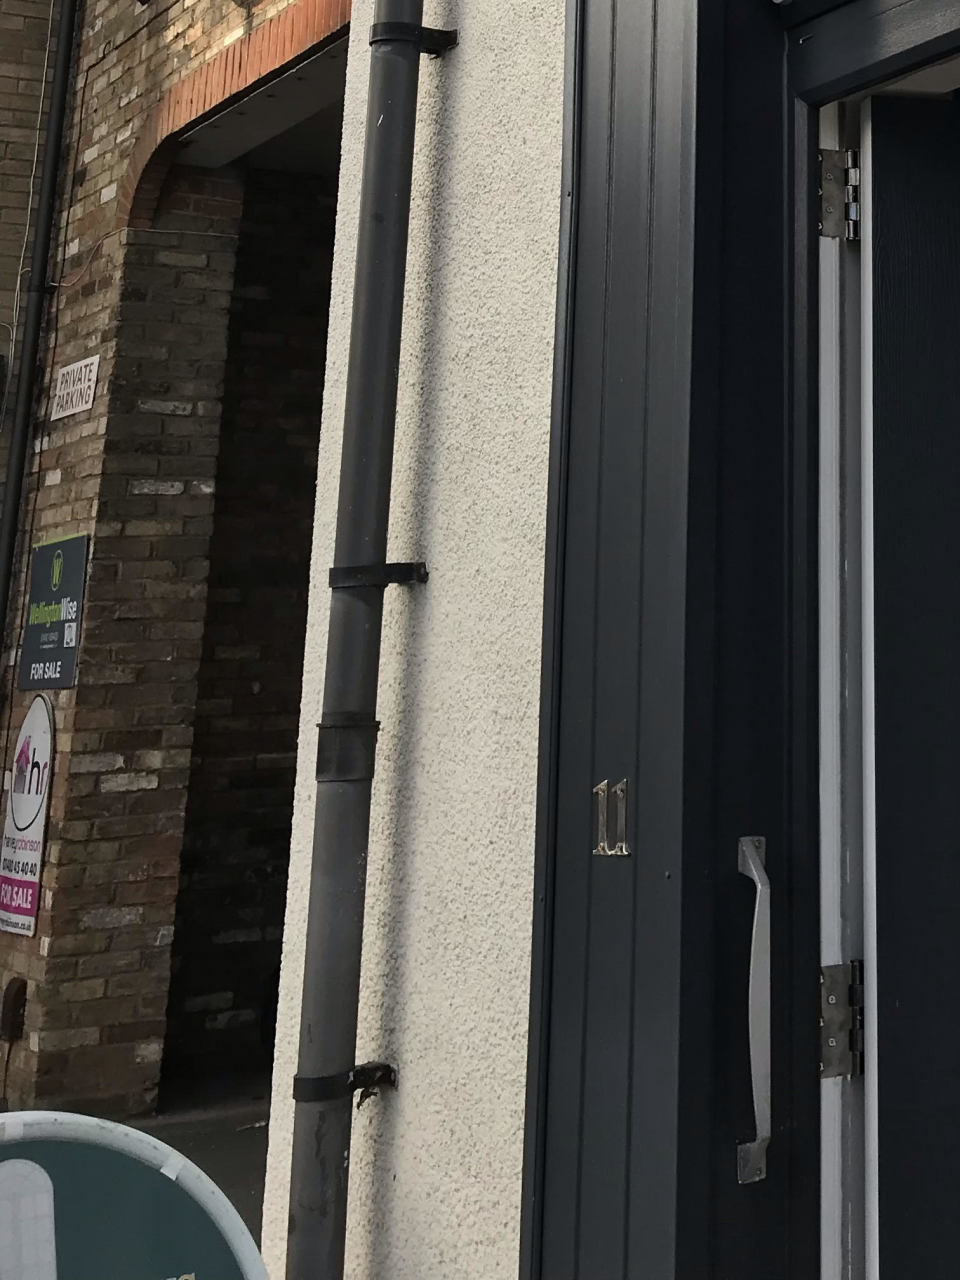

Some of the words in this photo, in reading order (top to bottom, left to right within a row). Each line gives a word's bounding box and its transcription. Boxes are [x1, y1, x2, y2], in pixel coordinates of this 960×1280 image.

[59, 361, 94, 391] PRIVATE
[56, 384, 92, 412] PARKING
[30, 663, 44, 680] FOR
[44, 661, 61, 679] SALE
[21, 862, 29, 876] 40
[29, 863, 37, 877] 40
[0, 883, 12, 905] FOR
[12, 886, 33, 909] SALE
